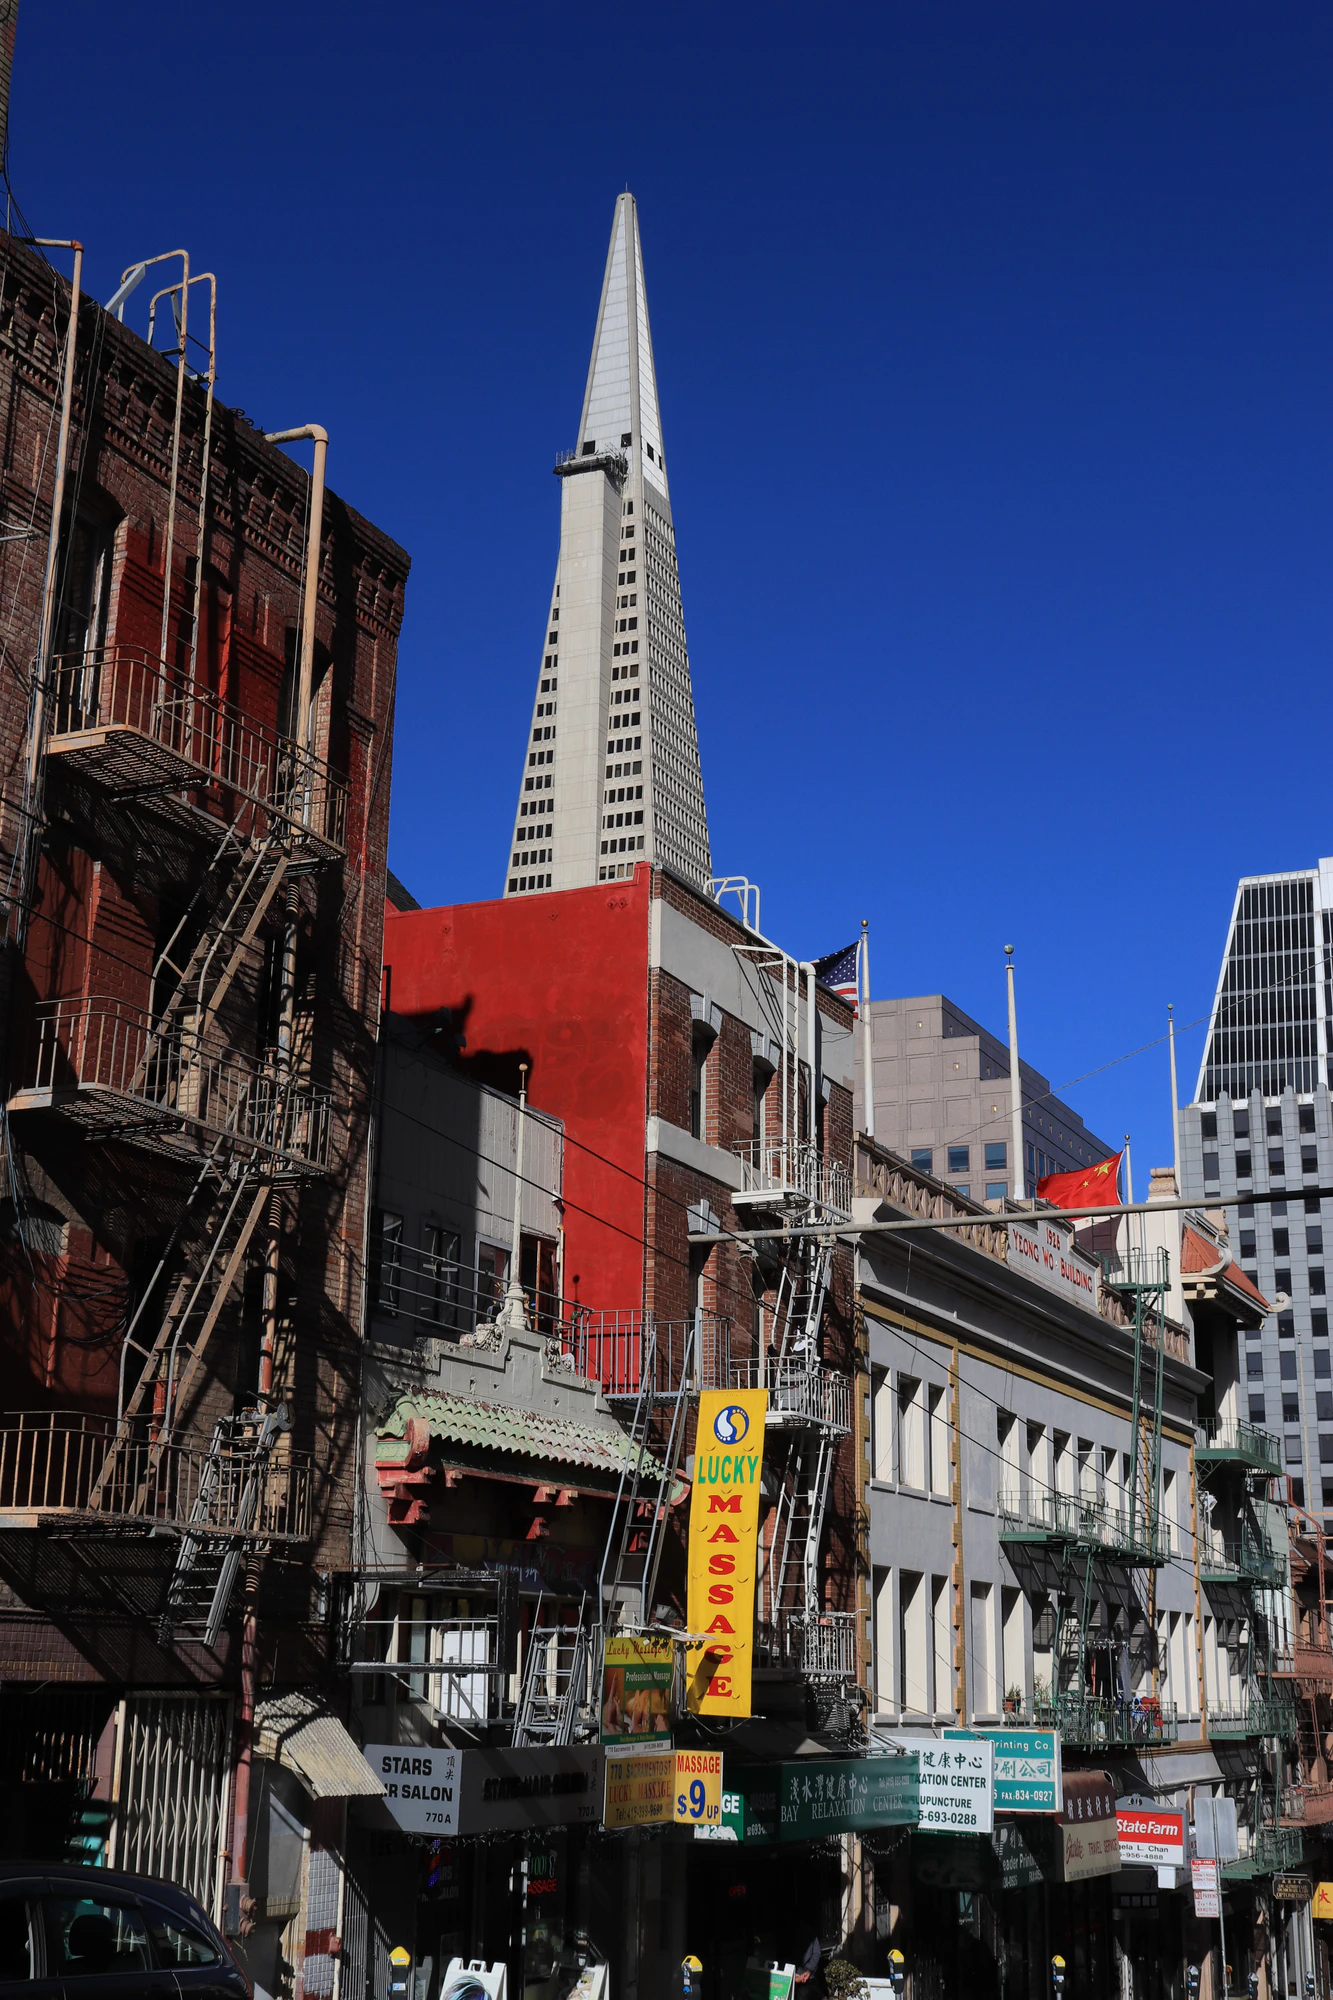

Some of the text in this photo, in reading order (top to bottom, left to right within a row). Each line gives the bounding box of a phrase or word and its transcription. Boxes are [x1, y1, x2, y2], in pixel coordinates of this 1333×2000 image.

[1012, 1229, 1093, 1293] YEONG WO BUILDING
[697, 1455, 759, 1484] LUCKY
[704, 1494, 743, 1698] MASSAGE
[607, 1640, 630, 1659] Lucky
[625, 1670, 671, 1683] Professional Massage
[1034, 1740, 1052, 1750] Co.
[382, 1756, 432, 1776] STARS
[610, 1763, 623, 1781] 770
[626, 1761, 664, 1779] SACRAMENTO
[677, 1754, 720, 1774] MASSAGE
[951, 1775, 987, 1789] CENTER
[401, 1784, 453, 1802] SALON
[609, 1780, 671, 1804] LUCKY MASSAGE
[706, 1804, 719, 1820] UP
[781, 1793, 904, 1823] BAY RELAXATION CENTER
[1088, 1841, 1103, 1856] TRAVEL
[1103, 1838, 1118, 1853] SERVICE
[1148, 1845, 1169, 1853] Chan
[1000, 1856, 1018, 1871] eader
